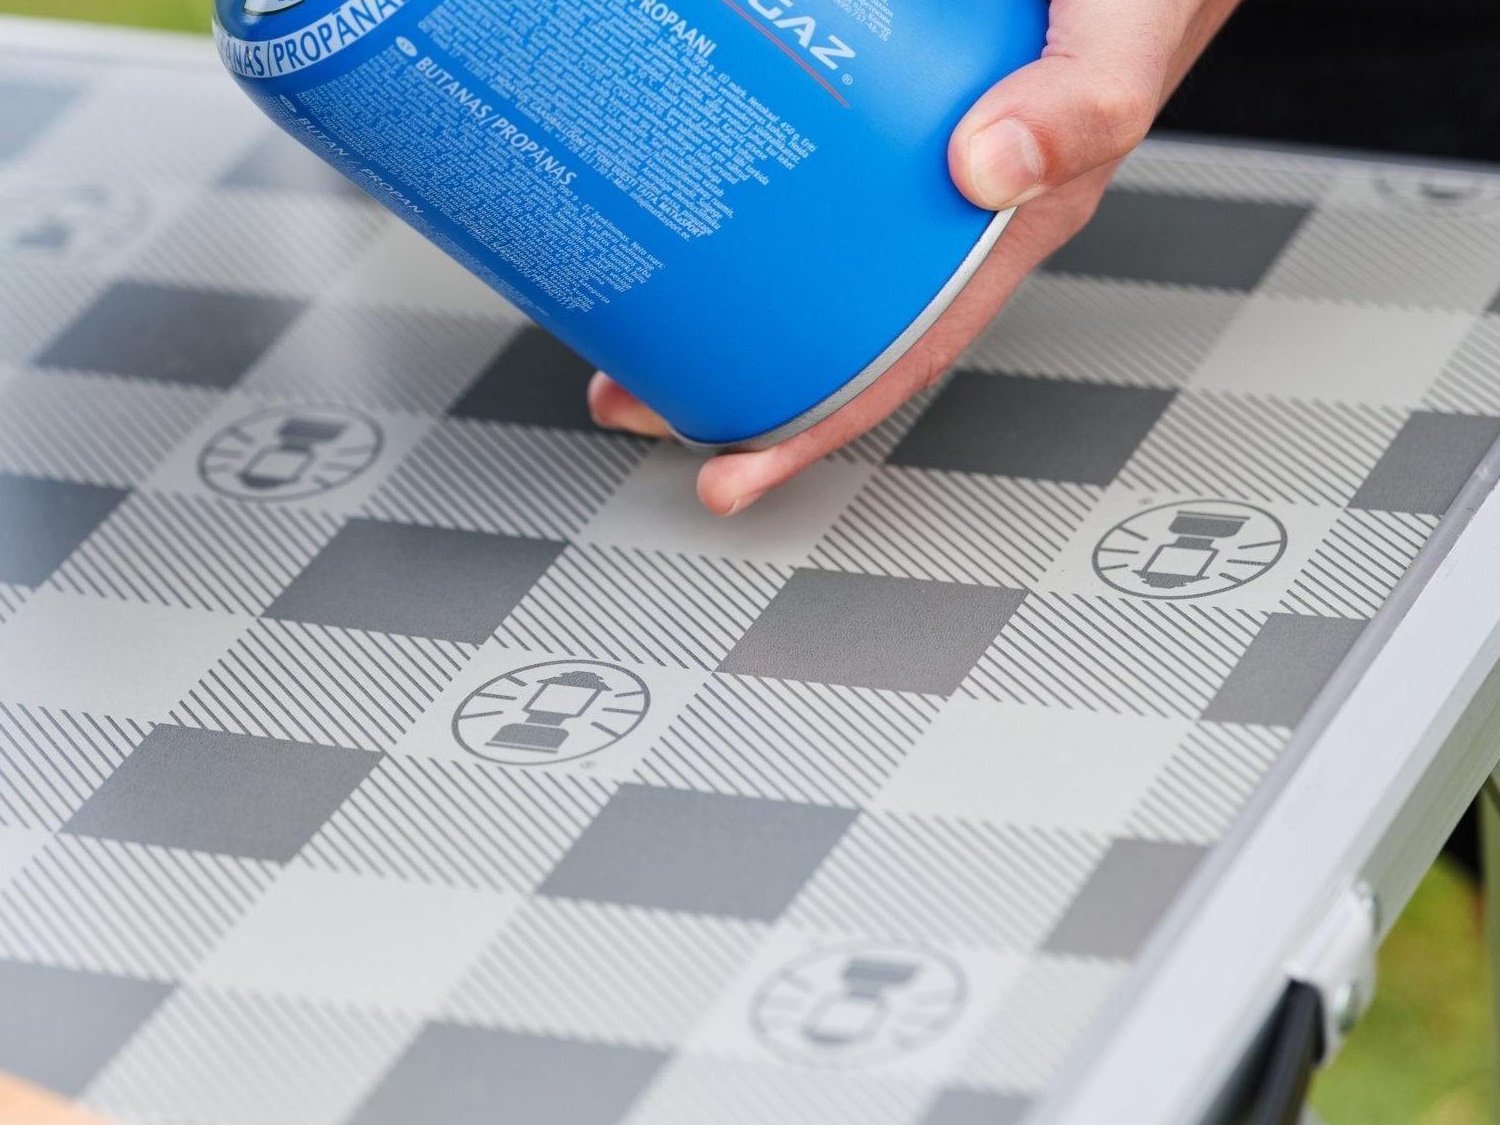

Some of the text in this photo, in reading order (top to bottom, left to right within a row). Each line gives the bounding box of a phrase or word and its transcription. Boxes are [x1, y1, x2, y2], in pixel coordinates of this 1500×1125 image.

[414, 55, 577, 186] BUTANAS/PROPĀNAS
[718, 84, 766, 124] ventileeritavas
[765, 121, 788, 141] kohas.
[787, 138, 809, 158] Hoida
[723, 101, 753, 126] muudest
[721, 110, 747, 133] arvatud
[765, 145, 778, 156] kui
[776, 153, 795, 169] leket
[779, 120, 794, 134] 450
[800, 137, 817, 152] Eriti
[297, 116, 349, 156] BUTAN
[360, 167, 423, 213] PROPAN
[564, 139, 580, 154] 726
[579, 150, 594, 164] 813
[593, 161, 607, 175] 130
[711, 150, 726, 163] ette
[719, 143, 734, 157] tohi
[745, 164, 769, 185] torkida
[734, 143, 756, 163] kohas.
[744, 141, 767, 160] otsese
[593, 150, 613, 167] TOHI
[611, 164, 637, 187] UUESTI
[640, 166, 672, 193] Asendage
[712, 162, 738, 184] arvatud
[701, 177, 724, 197] vastab
[660, 193, 681, 212] pessa,
[696, 197, 723, 221] Sulgege
[710, 196, 735, 219] ruumis,
[557, 184, 571, 196] 990
[630, 241, 646, 255] Neto
[580, 212, 602, 231] Laikyti
[600, 228, 619, 245] gerai
[564, 244, 585, 262] (arba)
[586, 235, 609, 255] nebent
[587, 227, 651, 278] atviros liepsnos arba
[570, 256, 605, 286] naudojama
[586, 253, 610, 273] Laikyti
[596, 252, 621, 274] Saugoti
[621, 272, 634, 283] nuo
